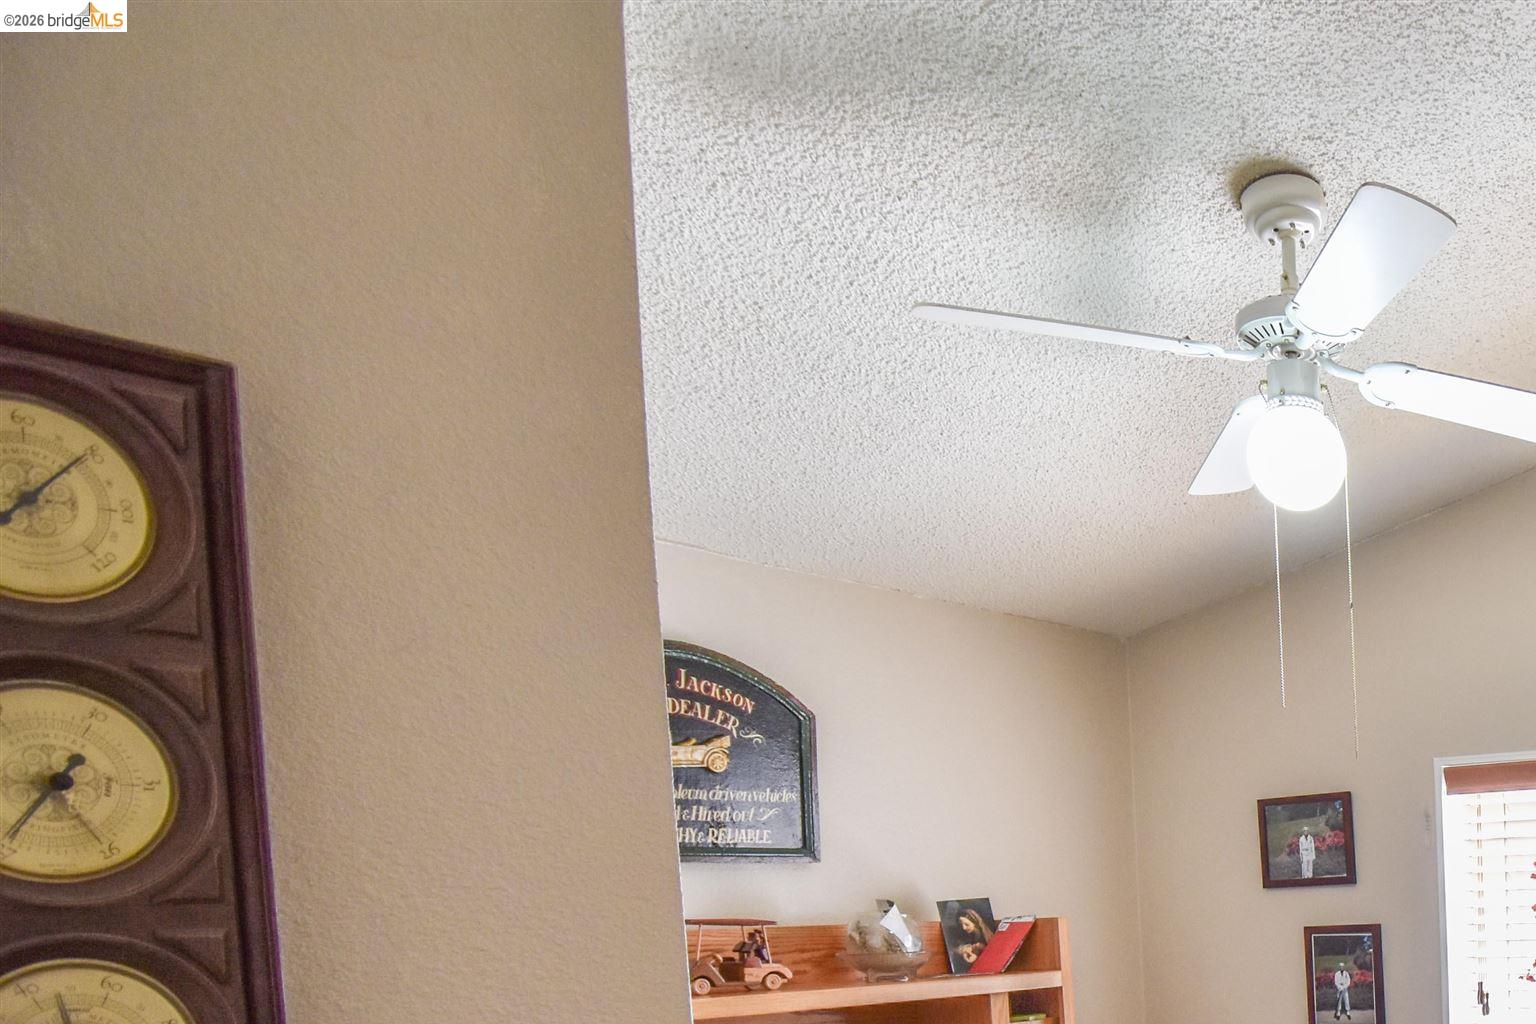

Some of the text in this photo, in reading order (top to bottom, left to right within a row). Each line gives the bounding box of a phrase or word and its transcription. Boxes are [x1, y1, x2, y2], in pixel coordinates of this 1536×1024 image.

[10, 408, 36, 427] 60
[675, 668, 755, 713] JACKSON
[667, 697, 739, 739] DEALER
[708, 784, 753, 801] driven
[753, 788, 798, 802] vehicles
[690, 805, 731, 822] Hired
[677, 827, 699, 843] HY
[707, 828, 772, 845] RELIABLE
[101, 976, 123, 993] 60
